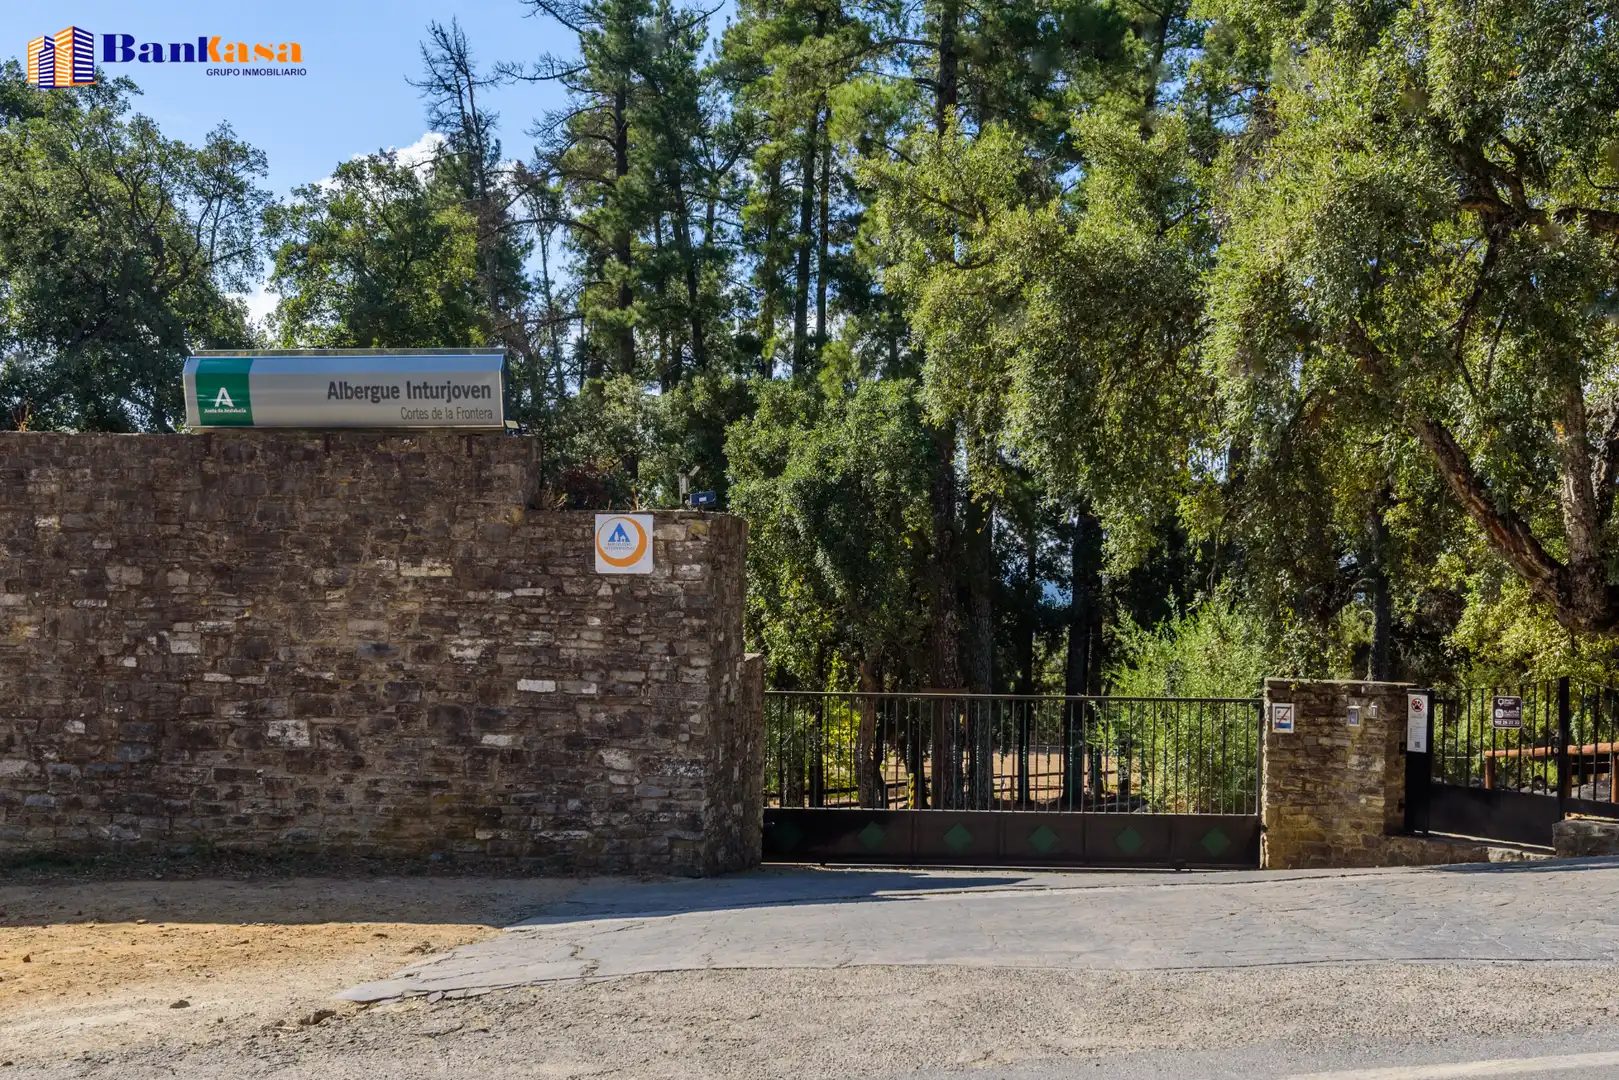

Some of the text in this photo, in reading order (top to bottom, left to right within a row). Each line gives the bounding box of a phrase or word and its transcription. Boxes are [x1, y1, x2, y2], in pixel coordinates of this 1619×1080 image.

[327, 380, 491, 404] Albergue Inturjoven
[401, 406, 493, 420] Cortes de la Frontera
